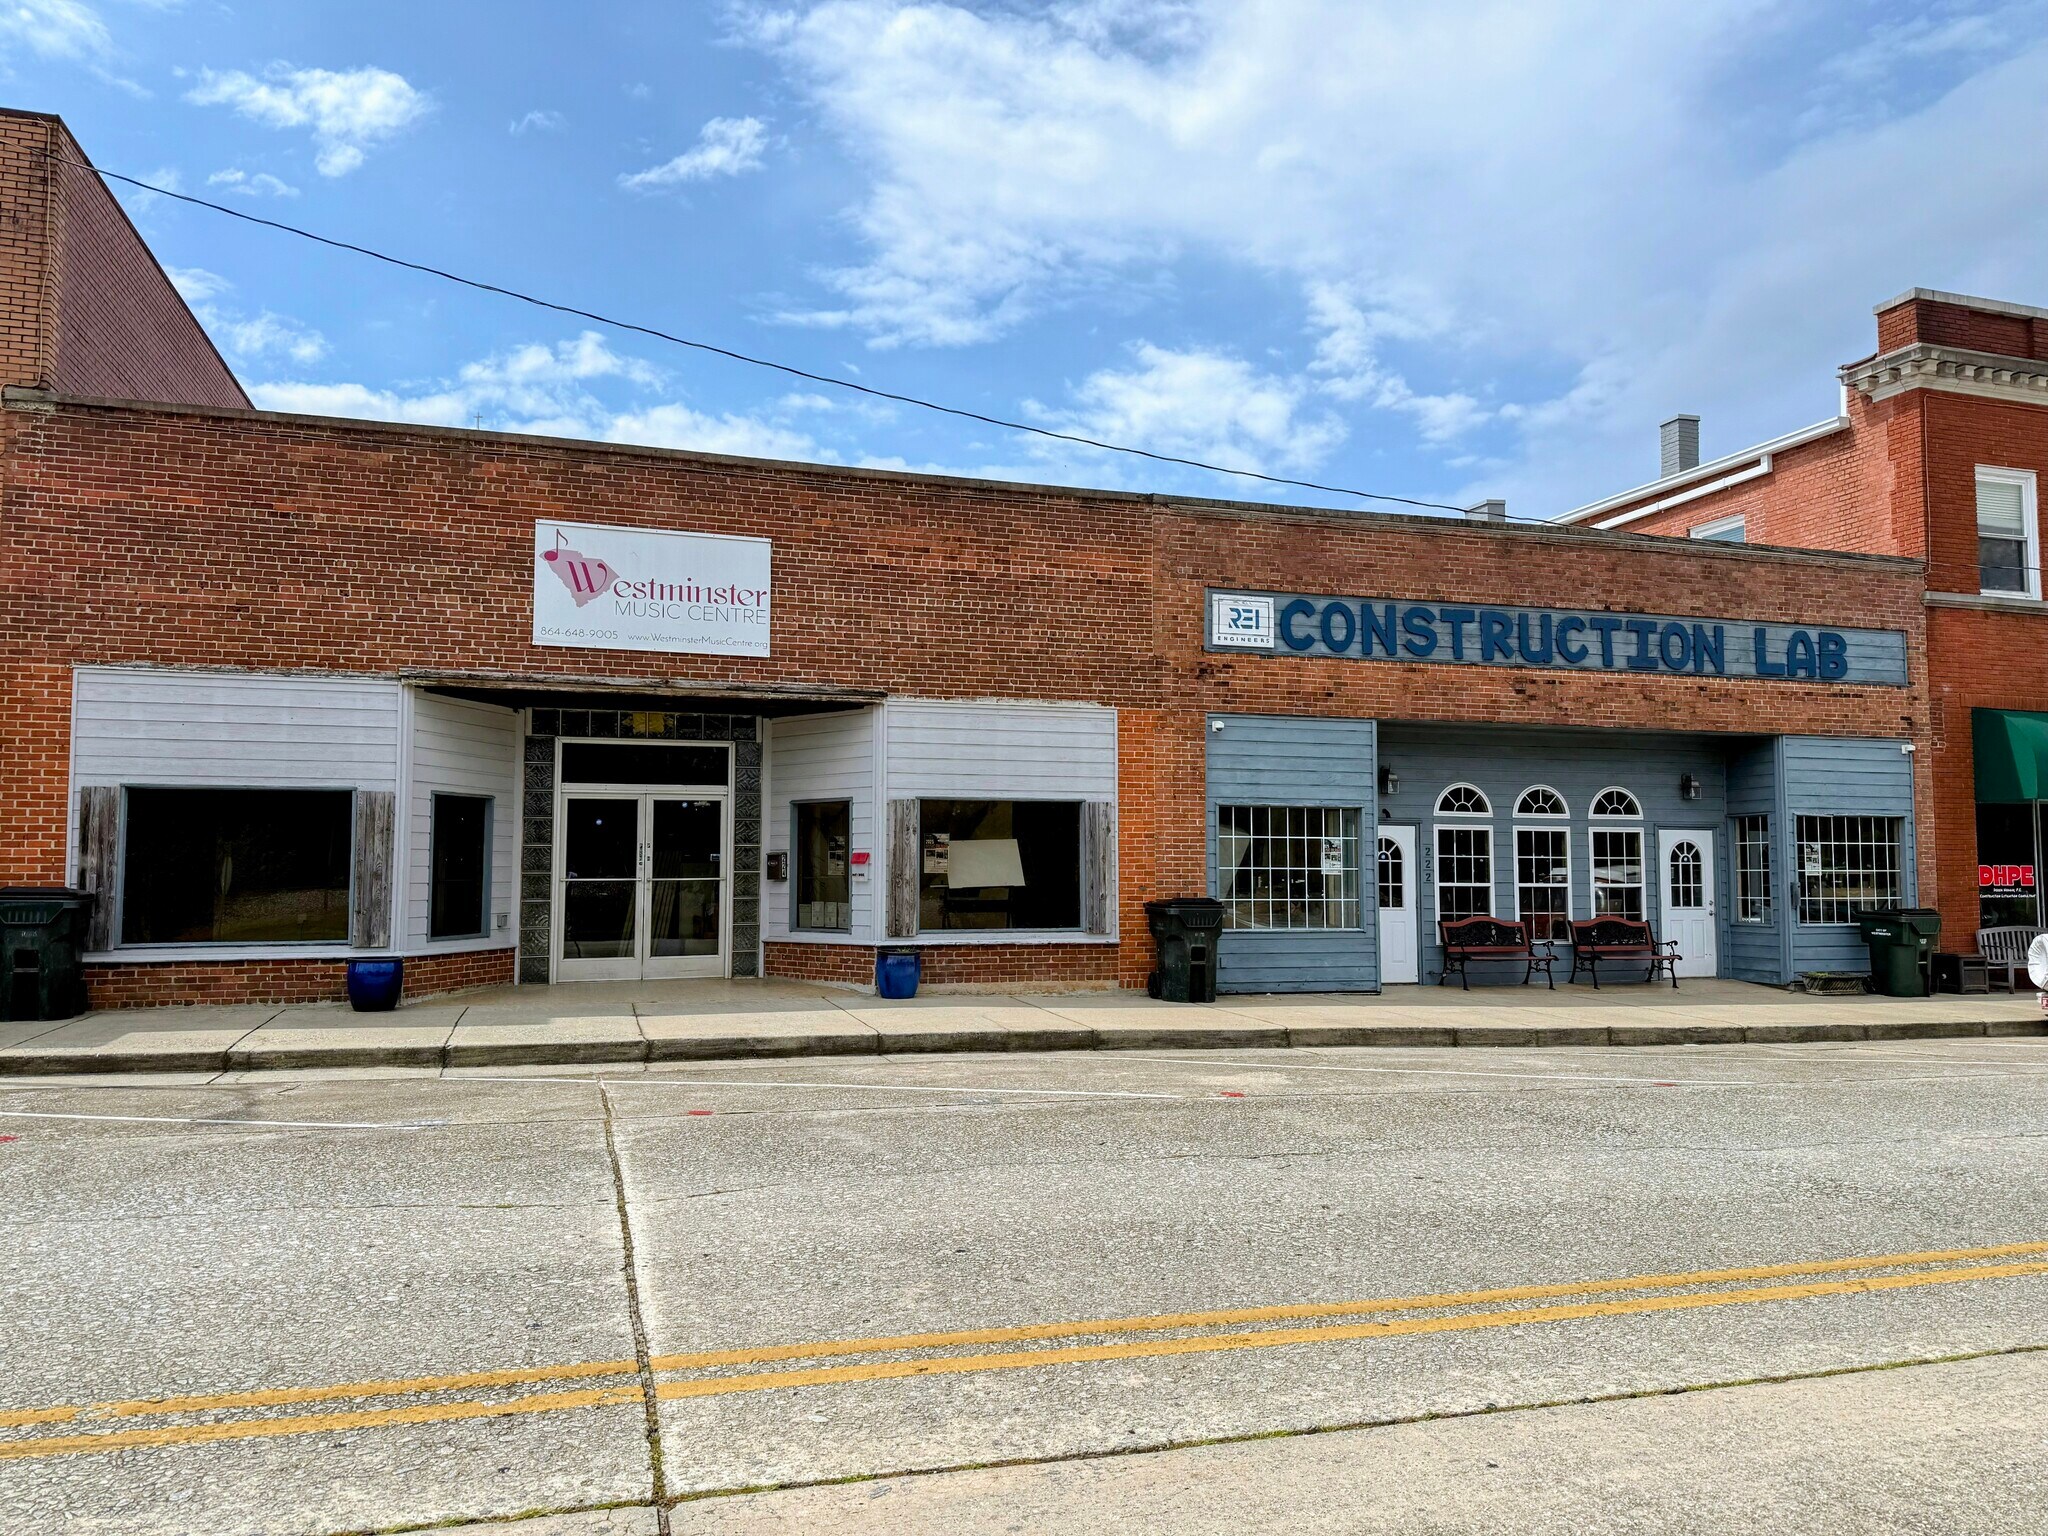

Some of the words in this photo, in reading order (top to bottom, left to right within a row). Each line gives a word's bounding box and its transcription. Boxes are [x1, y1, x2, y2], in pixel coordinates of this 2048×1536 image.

[566, 560, 767, 607] Westminster
[615, 600, 681, 620] MUSIC
[688, 605, 767, 625] CENTRE
[1229, 608, 1259, 629] REI
[540, 626, 619, 640] 864-648-9005
[1217, 635, 1270, 644] ENGINEERS
[1280, 599, 1725, 674] CONSTRUCTION
[1755, 627, 1847, 678] LAB
[1978, 865, 2035, 886] DHPE
